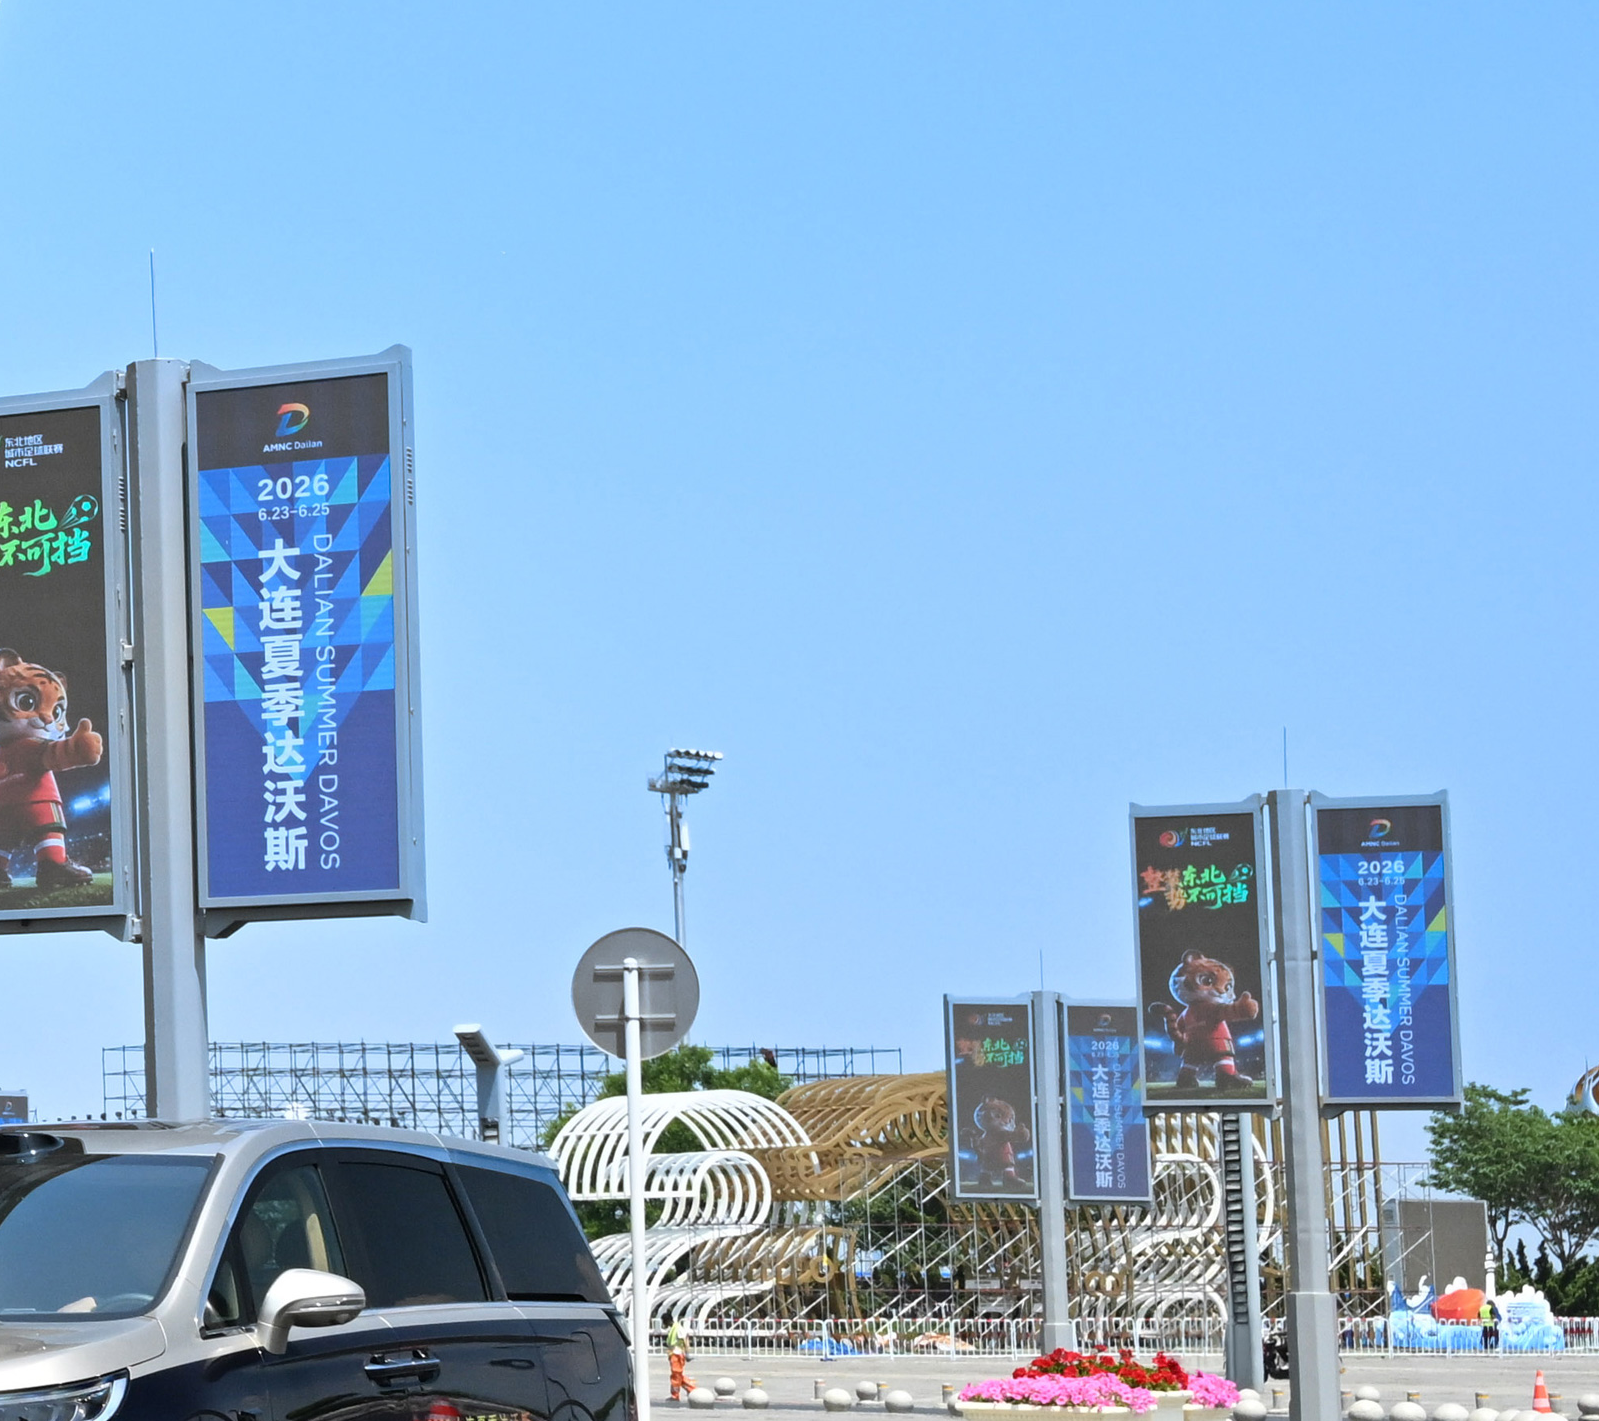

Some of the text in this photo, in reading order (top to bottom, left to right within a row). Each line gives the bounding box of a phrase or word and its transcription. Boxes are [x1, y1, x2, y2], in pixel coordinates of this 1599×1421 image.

[263, 440, 323, 453] AMNC Dalian
[5, 458, 38, 468] NCFL
[257, 473, 330, 501] 2026
[258, 503, 330, 521] 6.23-6.25
[258, 538, 308, 872] 大连夏季达沃斯
[313, 534, 340, 871] DALIAN SUMMER DAVOS
[1357, 860, 1405, 875] 2026
[1358, 895, 1394, 1085] 大连夏季达沃斯
[1394, 894, 1416, 1085] DALIAN SUMMER DAVOS
[1091, 1041, 1120, 1051] 2026
[1091, 1063, 1113, 1189] 大连夏季达沃斯
[1116, 1153, 1126, 1189] DAVOS
